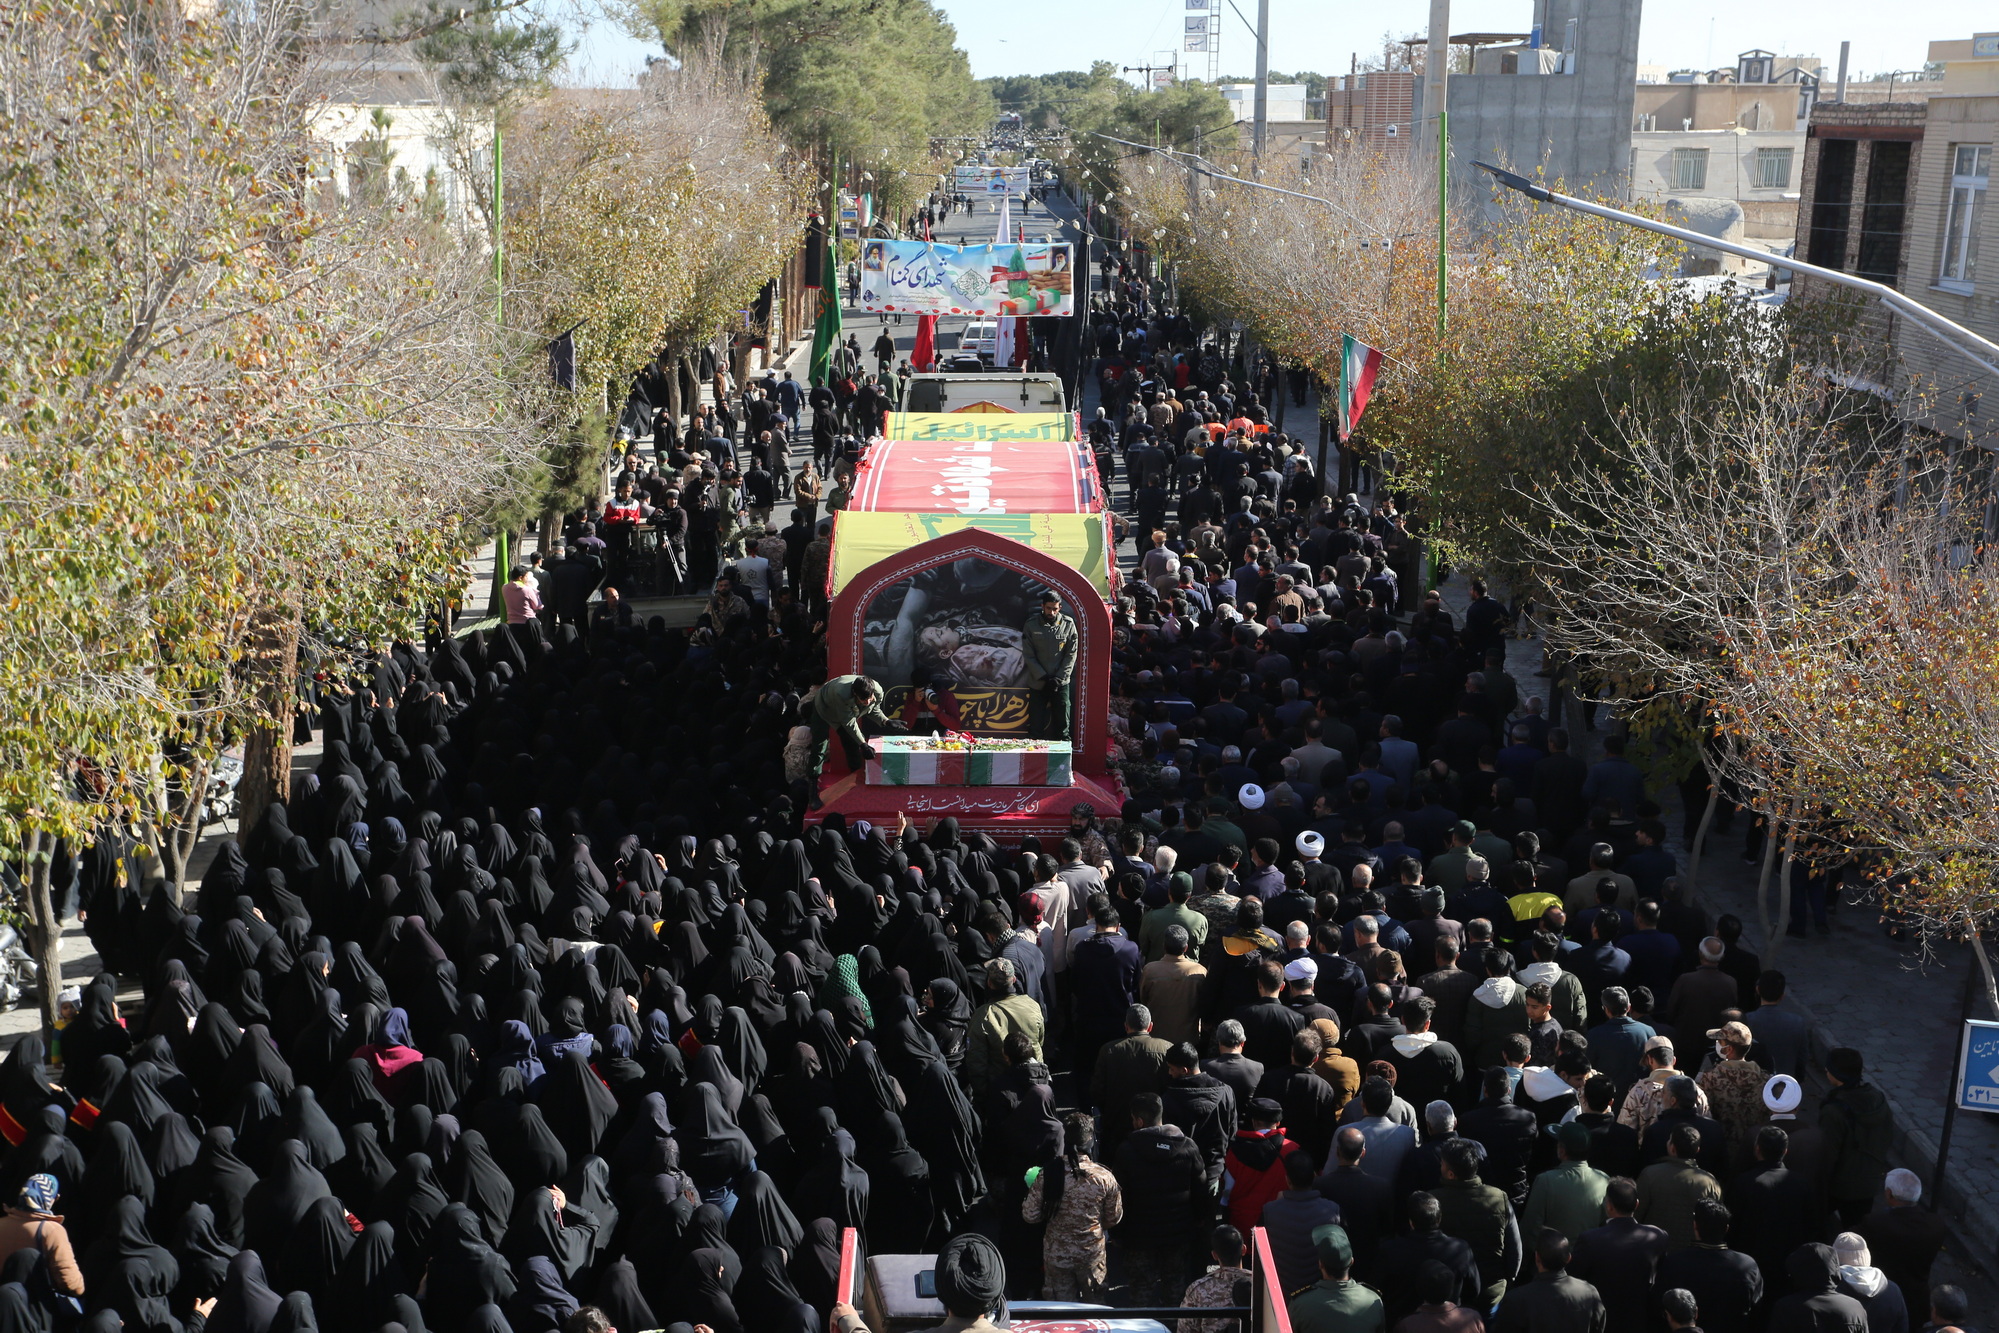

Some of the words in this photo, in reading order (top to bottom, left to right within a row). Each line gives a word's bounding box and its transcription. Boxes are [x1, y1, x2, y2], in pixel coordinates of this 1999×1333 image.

[1187, 18, 1206, 32] بانک
[886, 248, 928, 289] گمنام
[908, 257, 948, 289] شهدای
[977, 798, 1008, 810] مادرت
[992, 789, 1036, 814] کاش
[1024, 800, 1040, 814] ای
